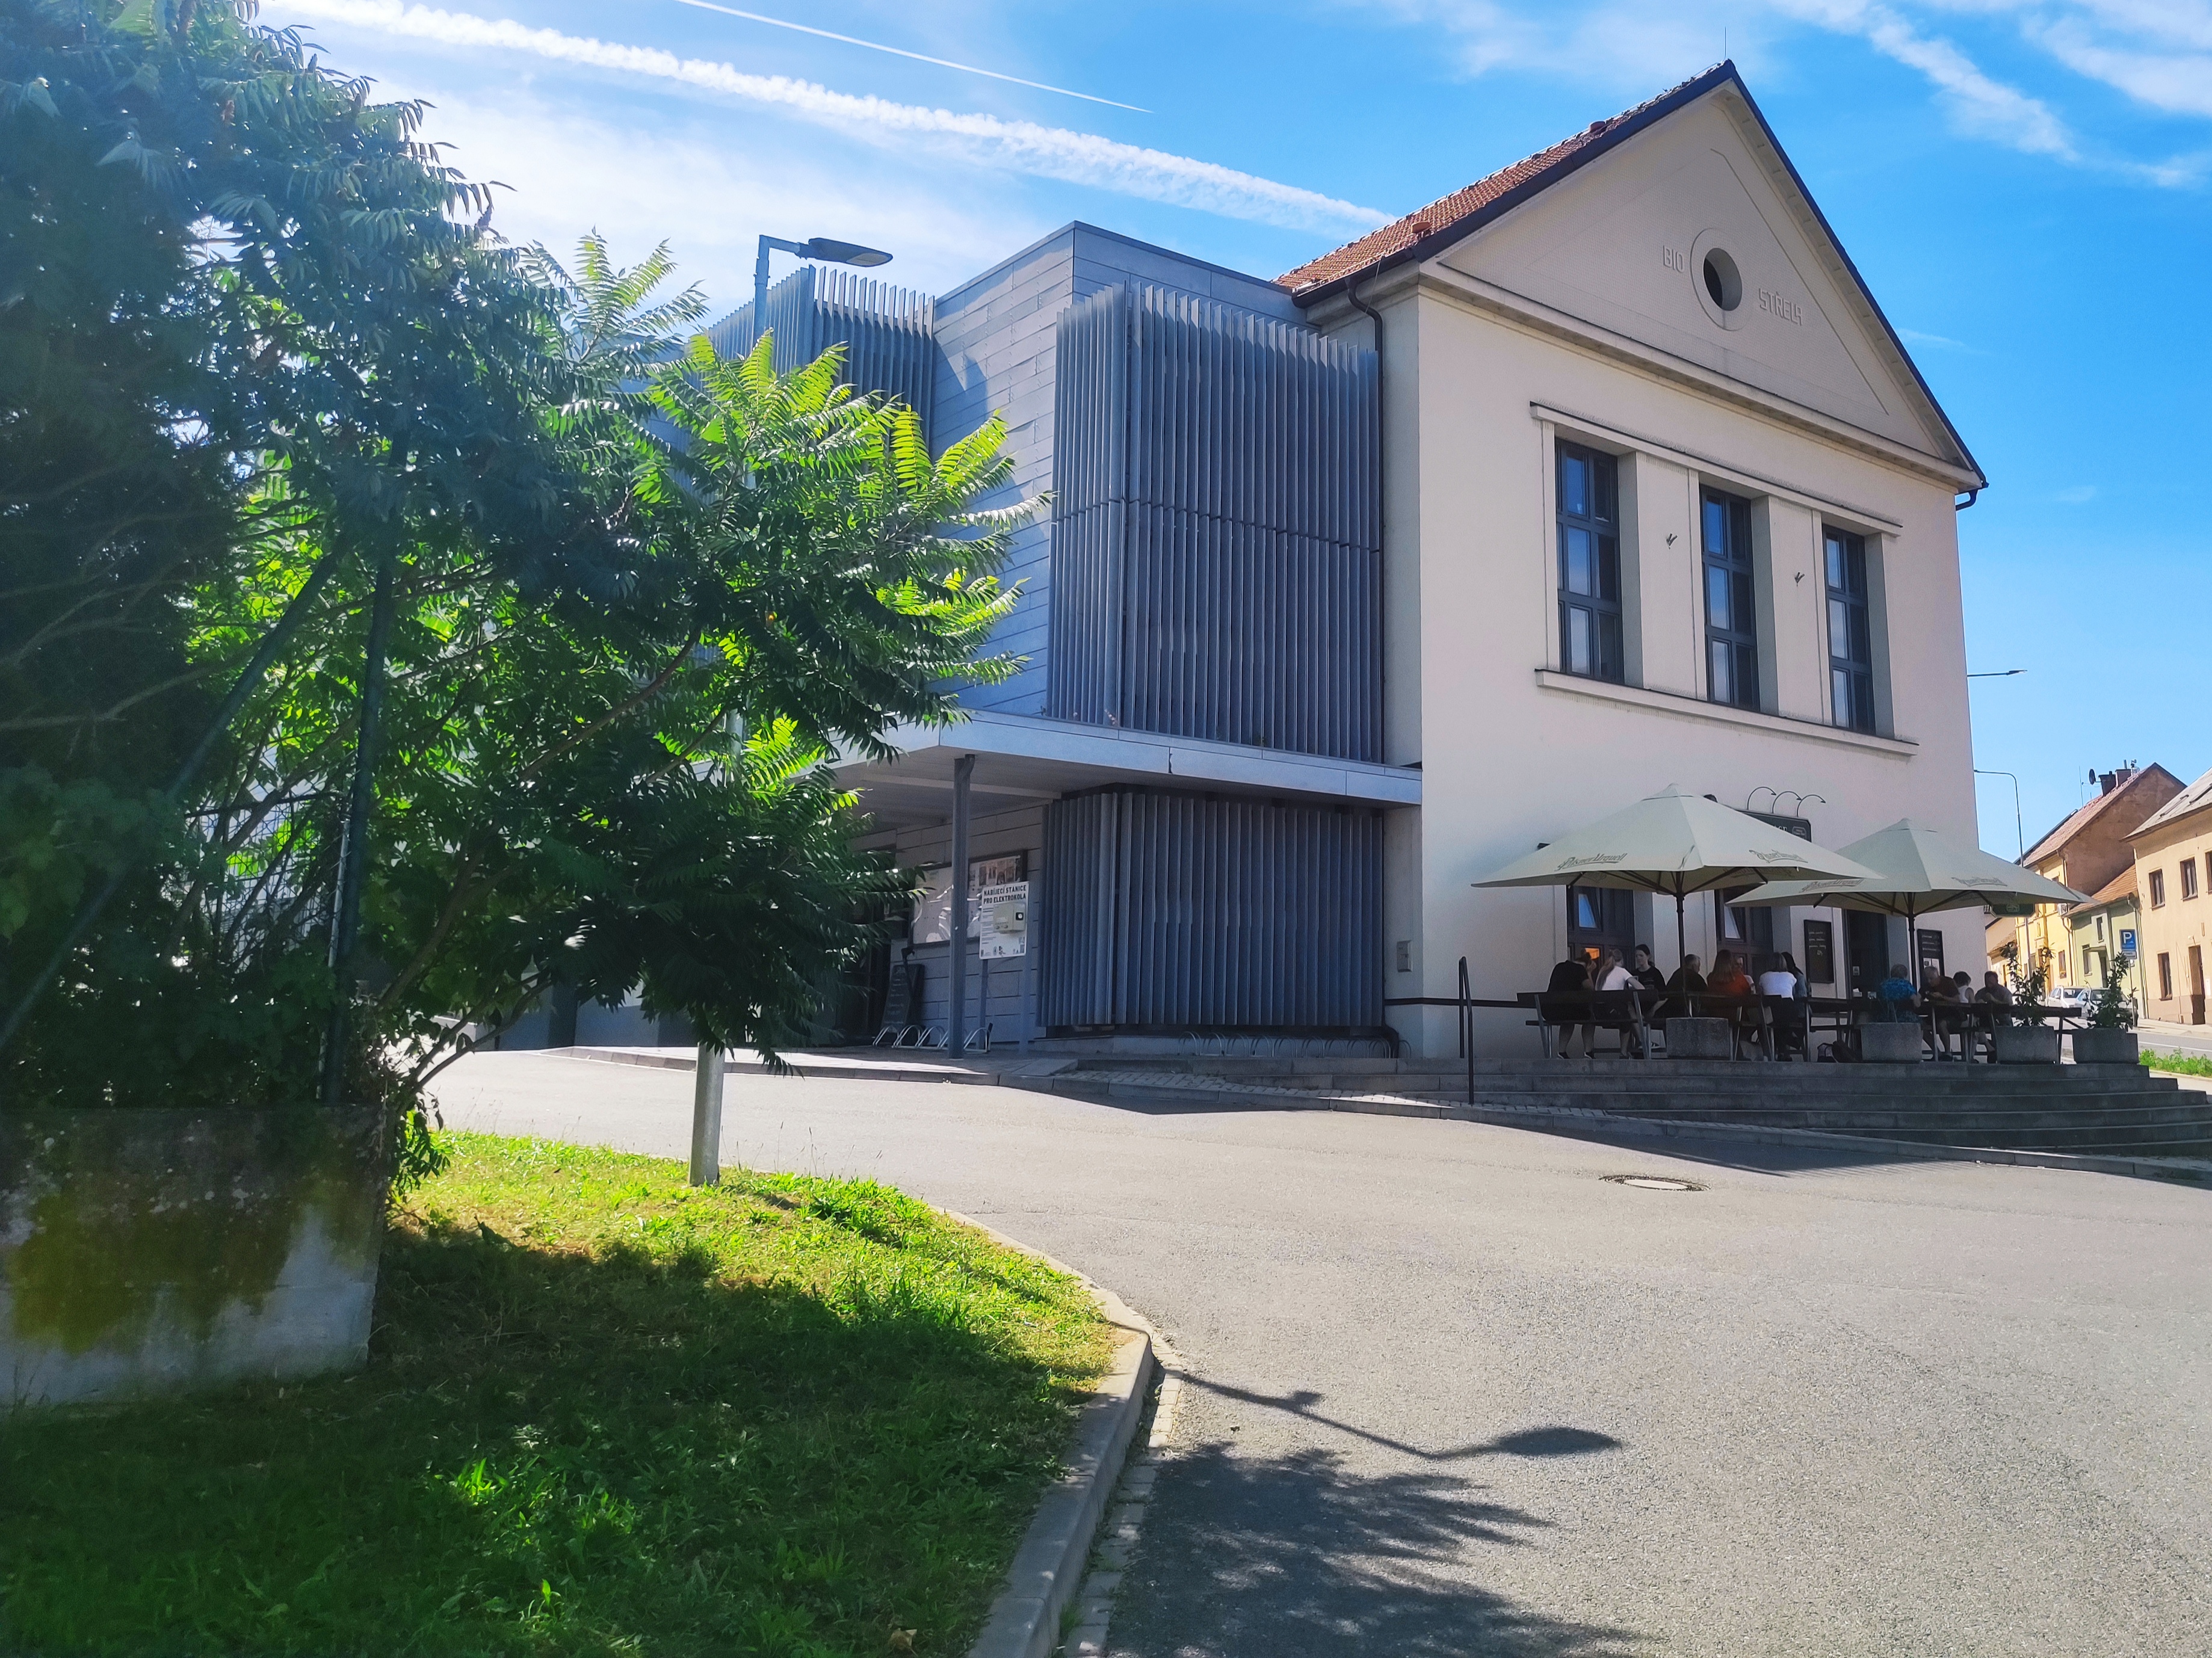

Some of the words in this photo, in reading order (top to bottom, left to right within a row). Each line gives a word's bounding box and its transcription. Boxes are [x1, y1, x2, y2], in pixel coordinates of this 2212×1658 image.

[1663, 245, 1684, 273] BIO
[1593, 853, 1628, 864] Urquell
[983, 885, 1006, 896] NABÍJECÍ
[1006, 885, 1027, 893] STANICE
[993, 893, 1026, 903] ELEKTROKOLA
[2123, 932, 2132, 944] P
